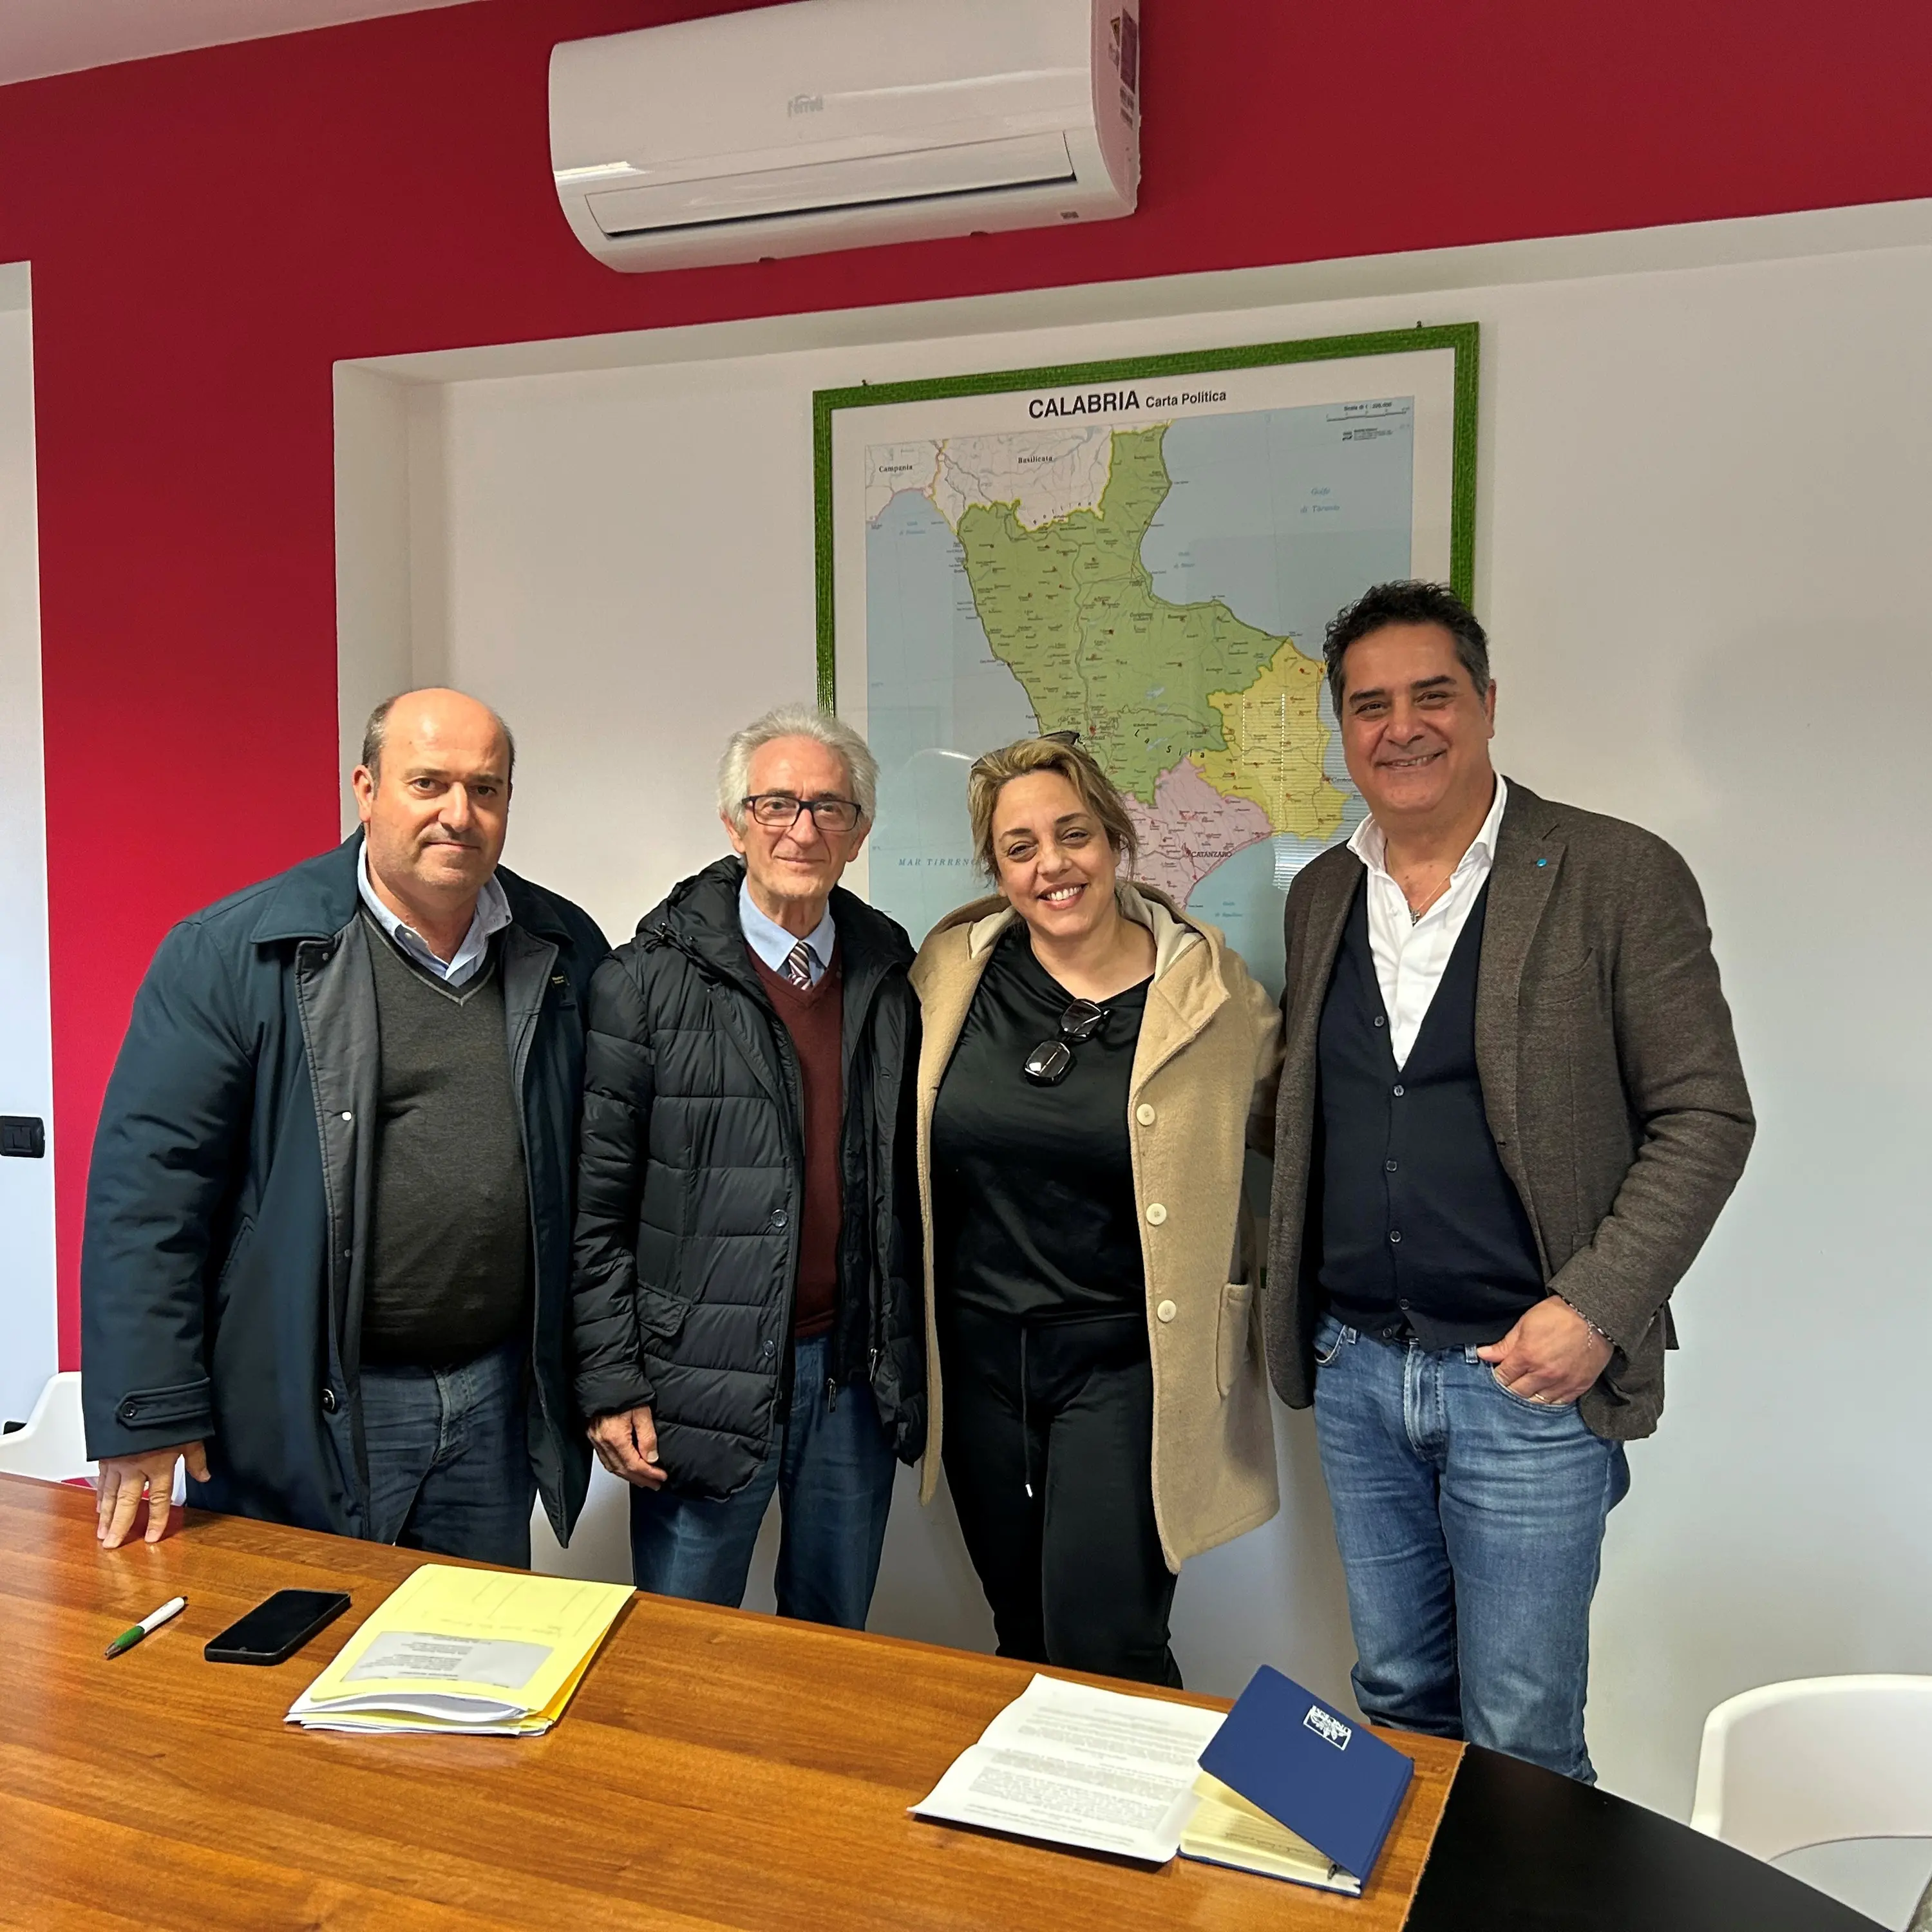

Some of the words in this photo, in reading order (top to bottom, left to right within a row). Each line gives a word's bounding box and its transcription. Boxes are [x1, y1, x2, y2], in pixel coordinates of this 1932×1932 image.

[1028, 390, 1140, 419] CALABRIA
[1146, 395, 1178, 408] Carta
[1181, 390, 1226, 405] Politica
[879, 464, 913, 473] Campania
[899, 858, 921, 866] MAR
